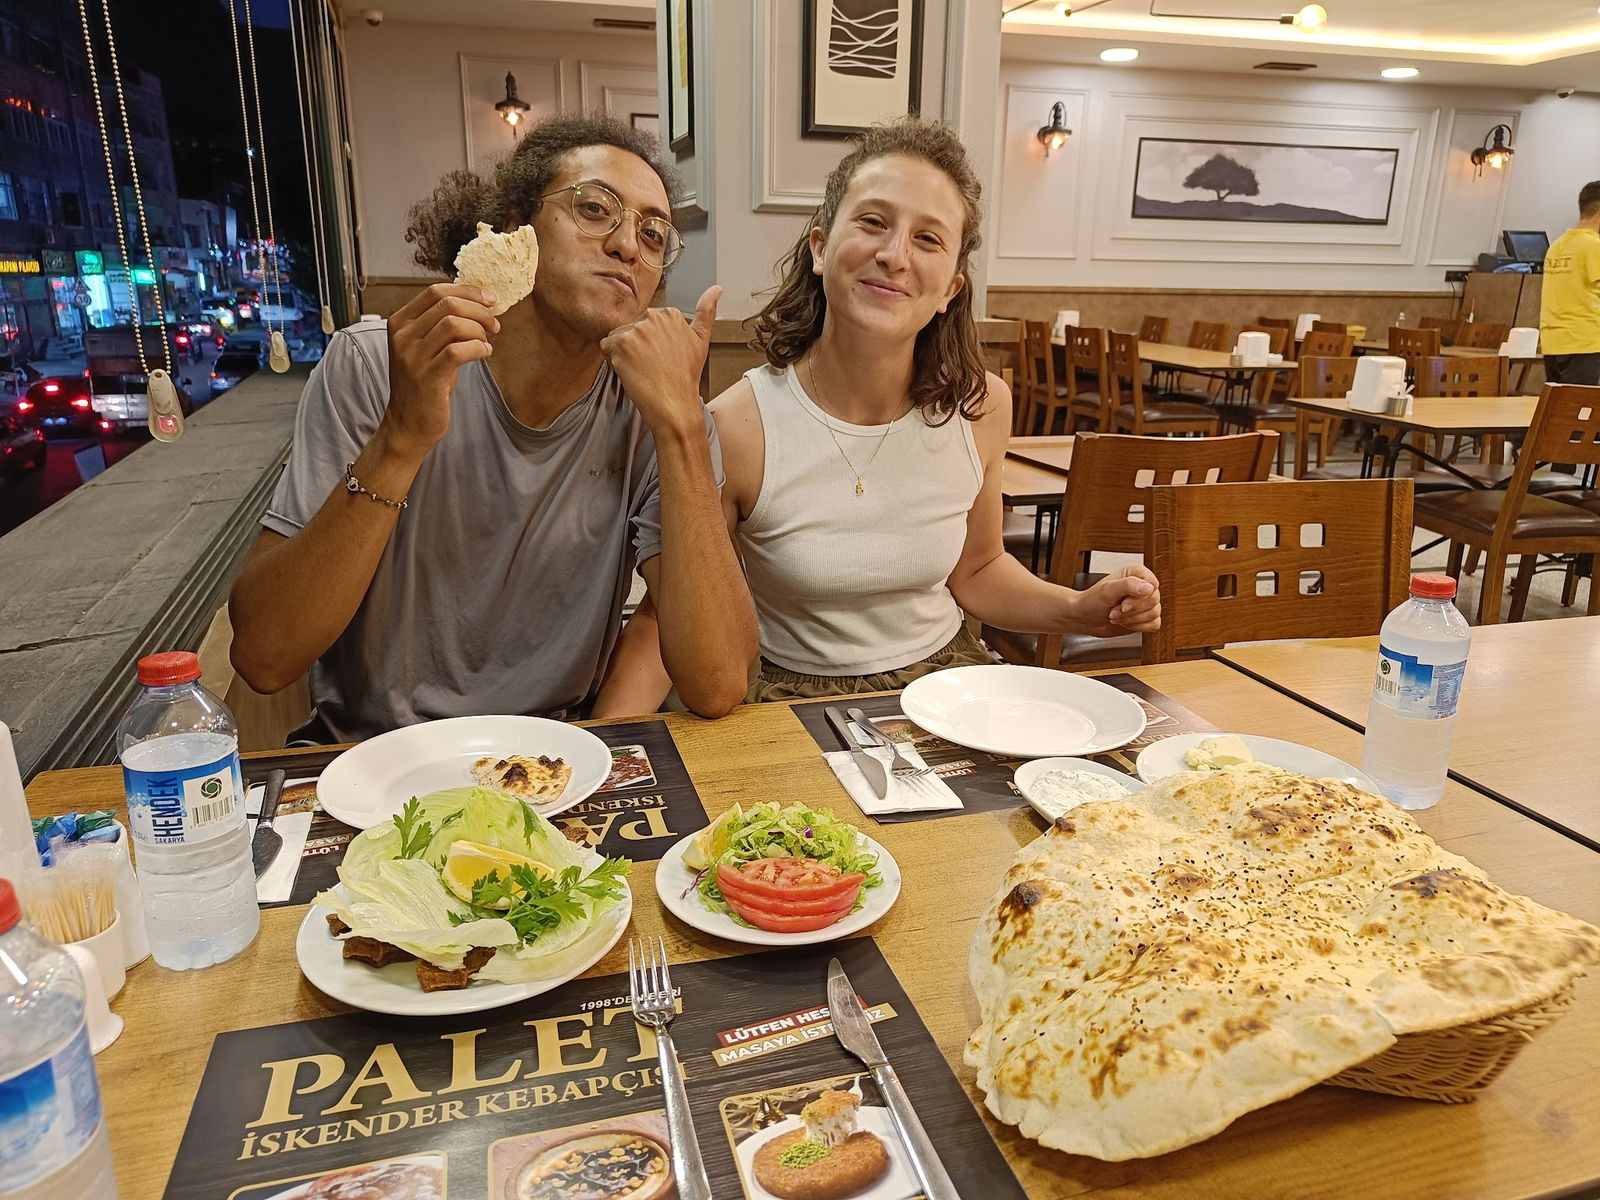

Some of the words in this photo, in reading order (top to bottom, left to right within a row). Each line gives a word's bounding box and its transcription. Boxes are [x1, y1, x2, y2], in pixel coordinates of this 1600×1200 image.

[146, 776, 184, 837] HENDEK
[567, 795, 666, 813] İSKEND
[154, 836, 185, 845] SAKARYA
[300, 845, 339, 857] LÜTF
[304, 835, 350, 847] MASA
[724, 1016, 795, 1044] LÜTFEN
[797, 1006, 831, 1024] HES
[245, 997, 682, 1129] PALET
[719, 1033, 800, 1063] MASAYA
[236, 1101, 472, 1161] İSKENDER
